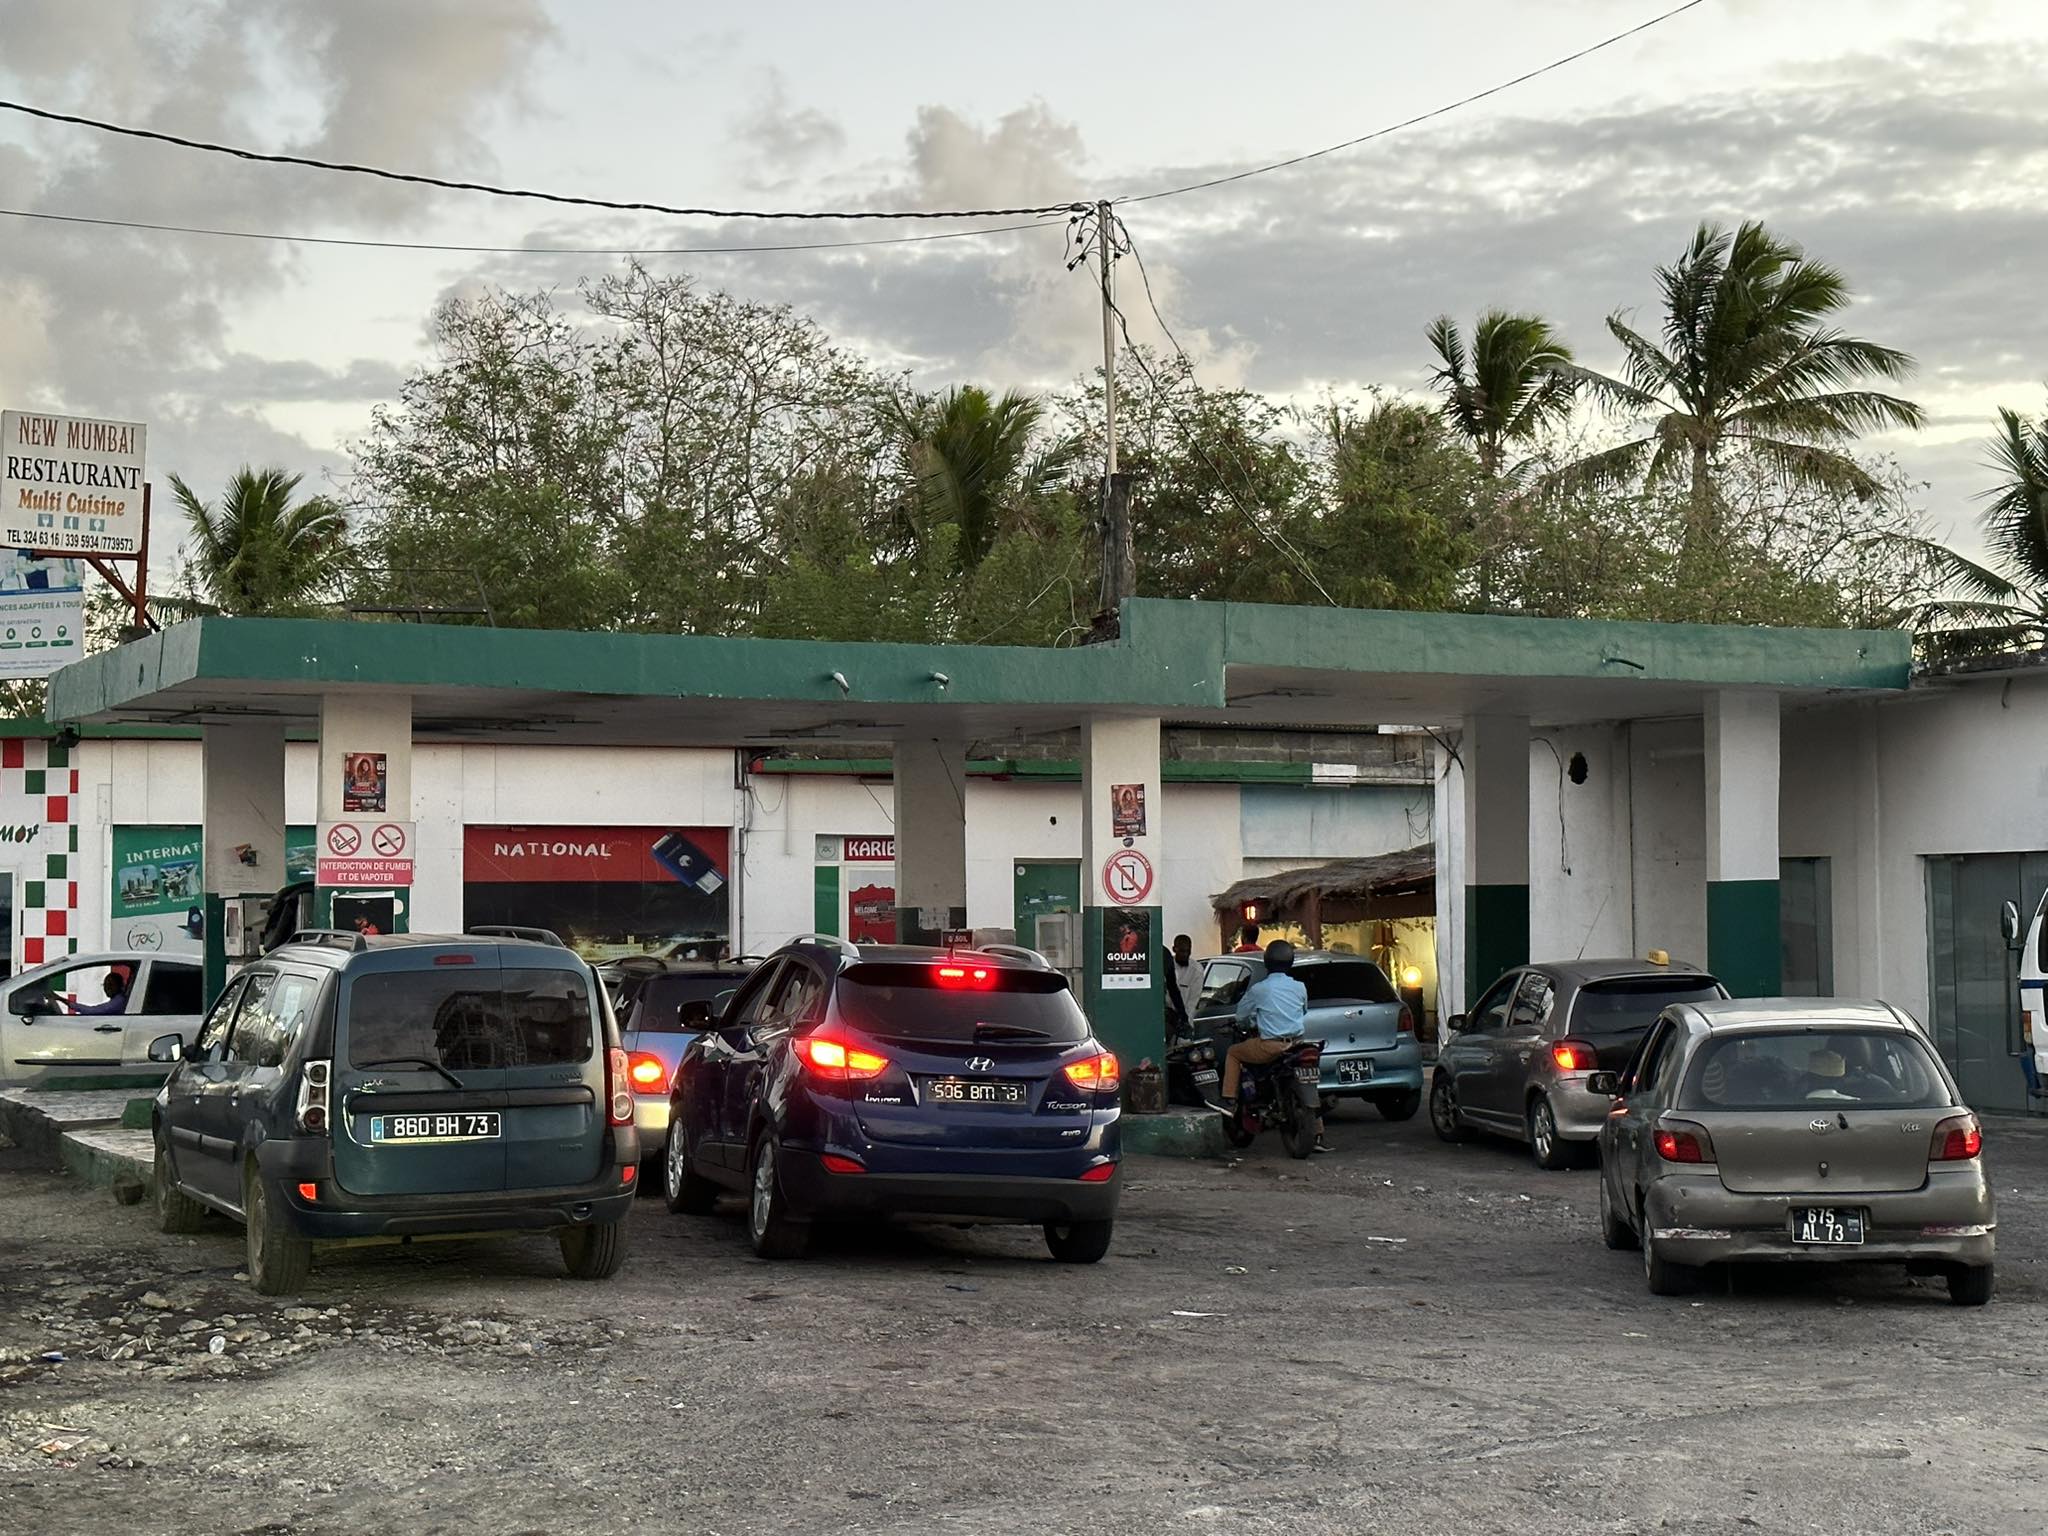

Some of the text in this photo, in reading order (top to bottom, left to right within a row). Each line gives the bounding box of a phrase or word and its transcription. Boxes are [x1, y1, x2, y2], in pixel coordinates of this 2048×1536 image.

[19, 416, 135, 454] NEW MUMBAI
[6, 456, 141, 489] RESTAURANT
[18, 488, 125, 516] Multi Cuisine
[7, 529, 21, 543] TEL
[23, 530, 37, 545] 324
[39, 532, 48, 545] 63
[51, 533, 59, 546] 16
[65, 534, 79, 548] 339
[80, 535, 99, 549] 5934
[63, 601, 80, 609] TOUS
[494, 842, 612, 857] NATIONAL
[320, 861, 411, 870] INTERDICTION DE FUMER
[337, 872, 394, 881] ET DE VAPOTER
[1107, 952, 1146, 961] GOULAM
[1349, 1070, 1360, 1081] 73
[394, 1115, 488, 1137] 860 BH 73
[1808, 1208, 1835, 1224] 675
[1802, 1223, 1844, 1241] AL 73
